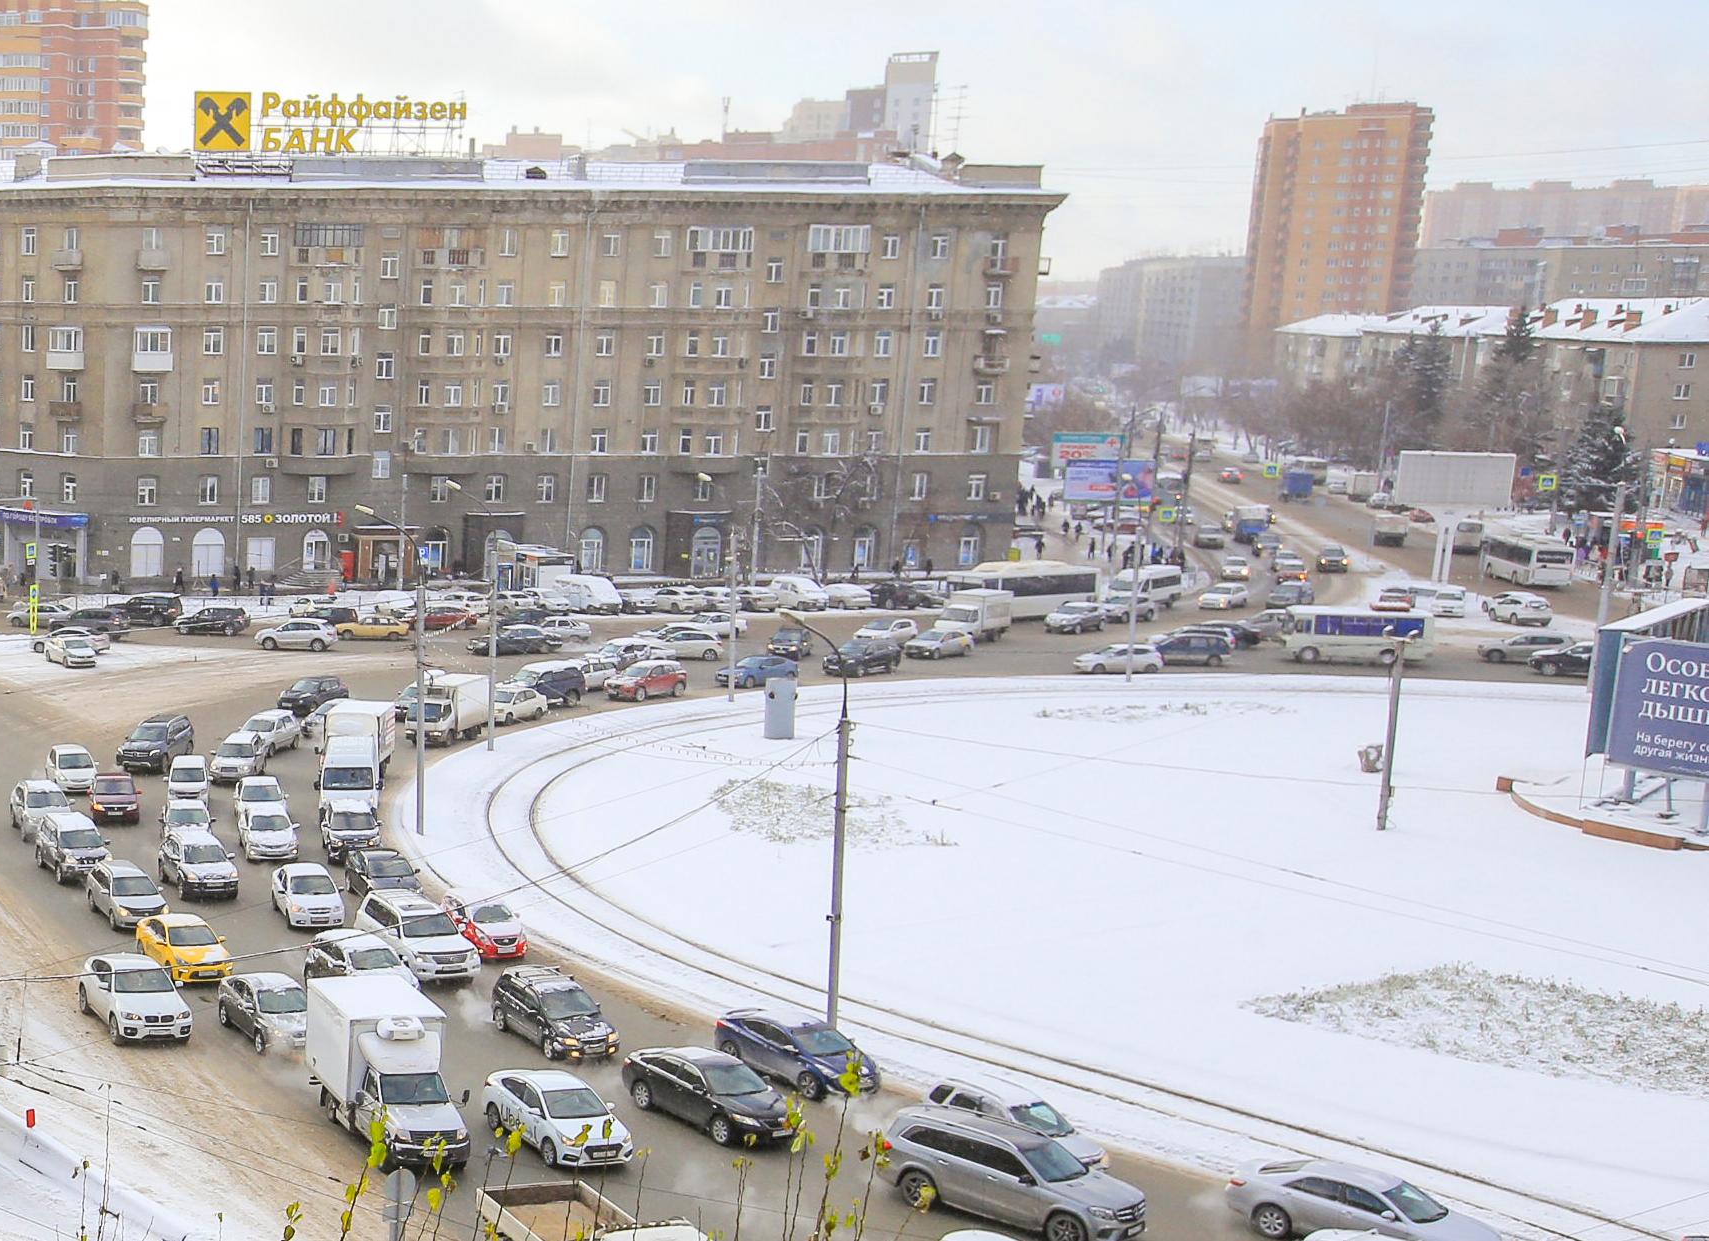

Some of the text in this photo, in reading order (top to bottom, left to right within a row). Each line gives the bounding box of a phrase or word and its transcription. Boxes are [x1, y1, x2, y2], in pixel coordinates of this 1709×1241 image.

[261, 91, 467, 127] Райффайзен
[261, 127, 359, 153] БАНК
[129, 515, 235, 523] ЮВЕЛИРНЫЙ ГИПЕРМАРКЕТ
[241, 512, 331, 524] 585 ЗОЛОТОЙ
[1637, 700, 1709, 725] ДЫШ
[1636, 731, 1652, 743] На
[1653, 734, 1697, 752] берегу
[1633, 744, 1709, 764] другая жизн
